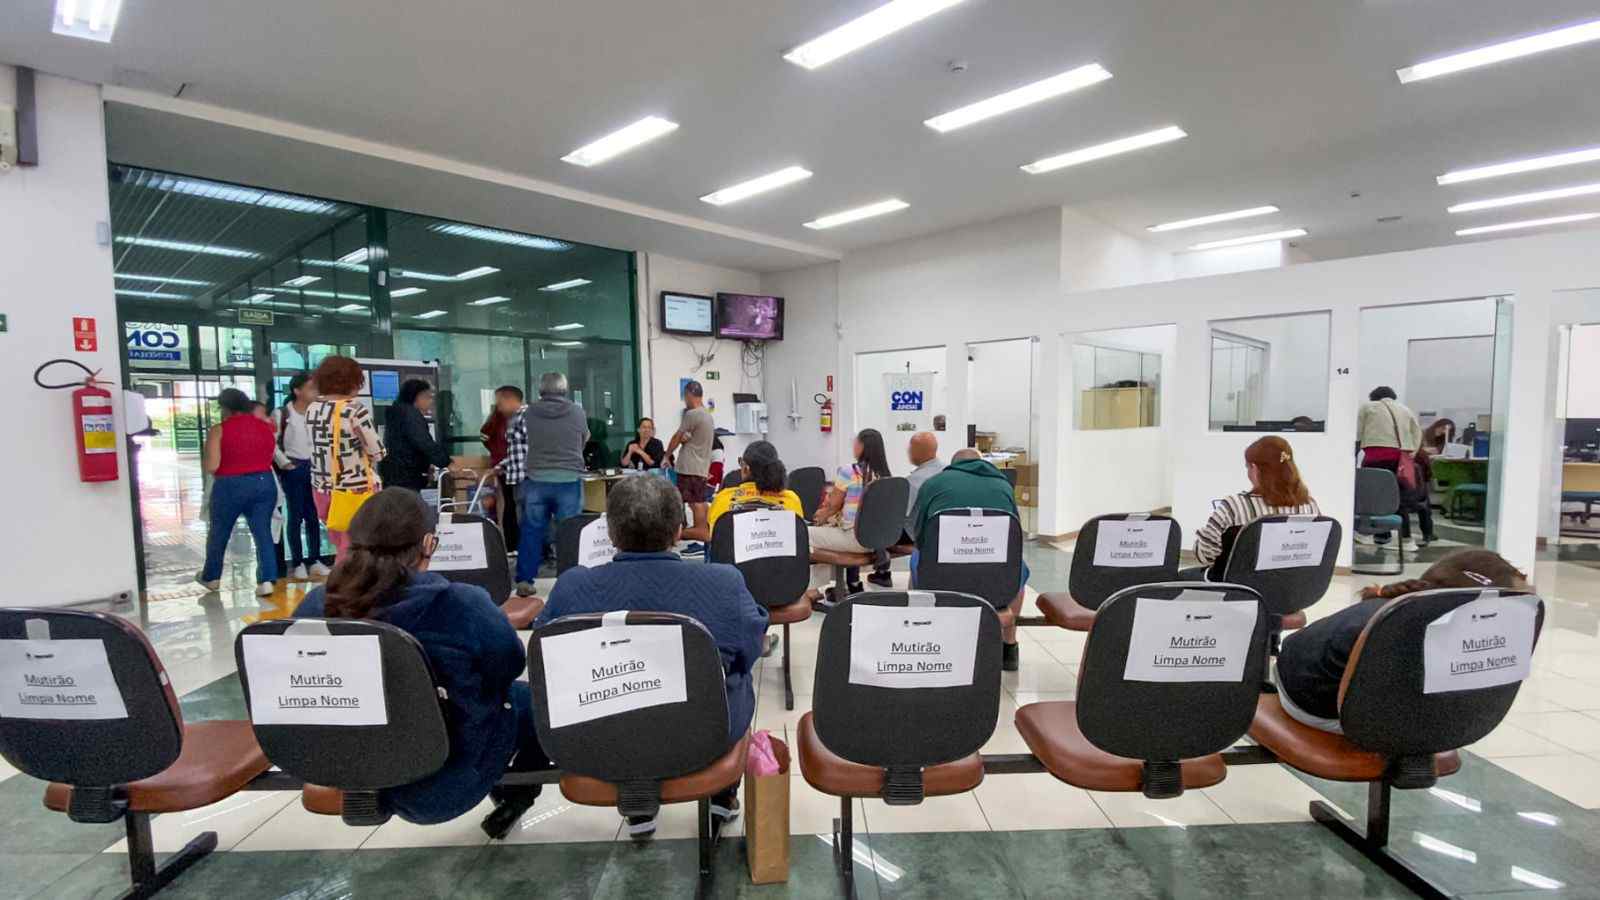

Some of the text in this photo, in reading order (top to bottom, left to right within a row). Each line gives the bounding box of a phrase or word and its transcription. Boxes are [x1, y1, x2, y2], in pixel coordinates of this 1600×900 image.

[1336, 367, 1350, 376] 14
[891, 391, 923, 403] CON
[890, 642, 941, 654] Mutirão
[1169, 636, 1217, 648] Mutirão
[1462, 635, 1506, 651] Mutirão
[877, 661, 953, 673] Limpa Nome
[1153, 655, 1226, 667] Limpa Nome
[1450, 655, 1517, 674] Limpa Nome
[591, 660, 645, 681] Mutirão
[24, 674, 75, 686] Mutirão
[290, 674, 343, 687] Mutirão
[578, 678, 662, 704] Limpa Nome
[18, 692, 96, 704] Limpa Nome
[278, 695, 360, 708] Limpa Nome
